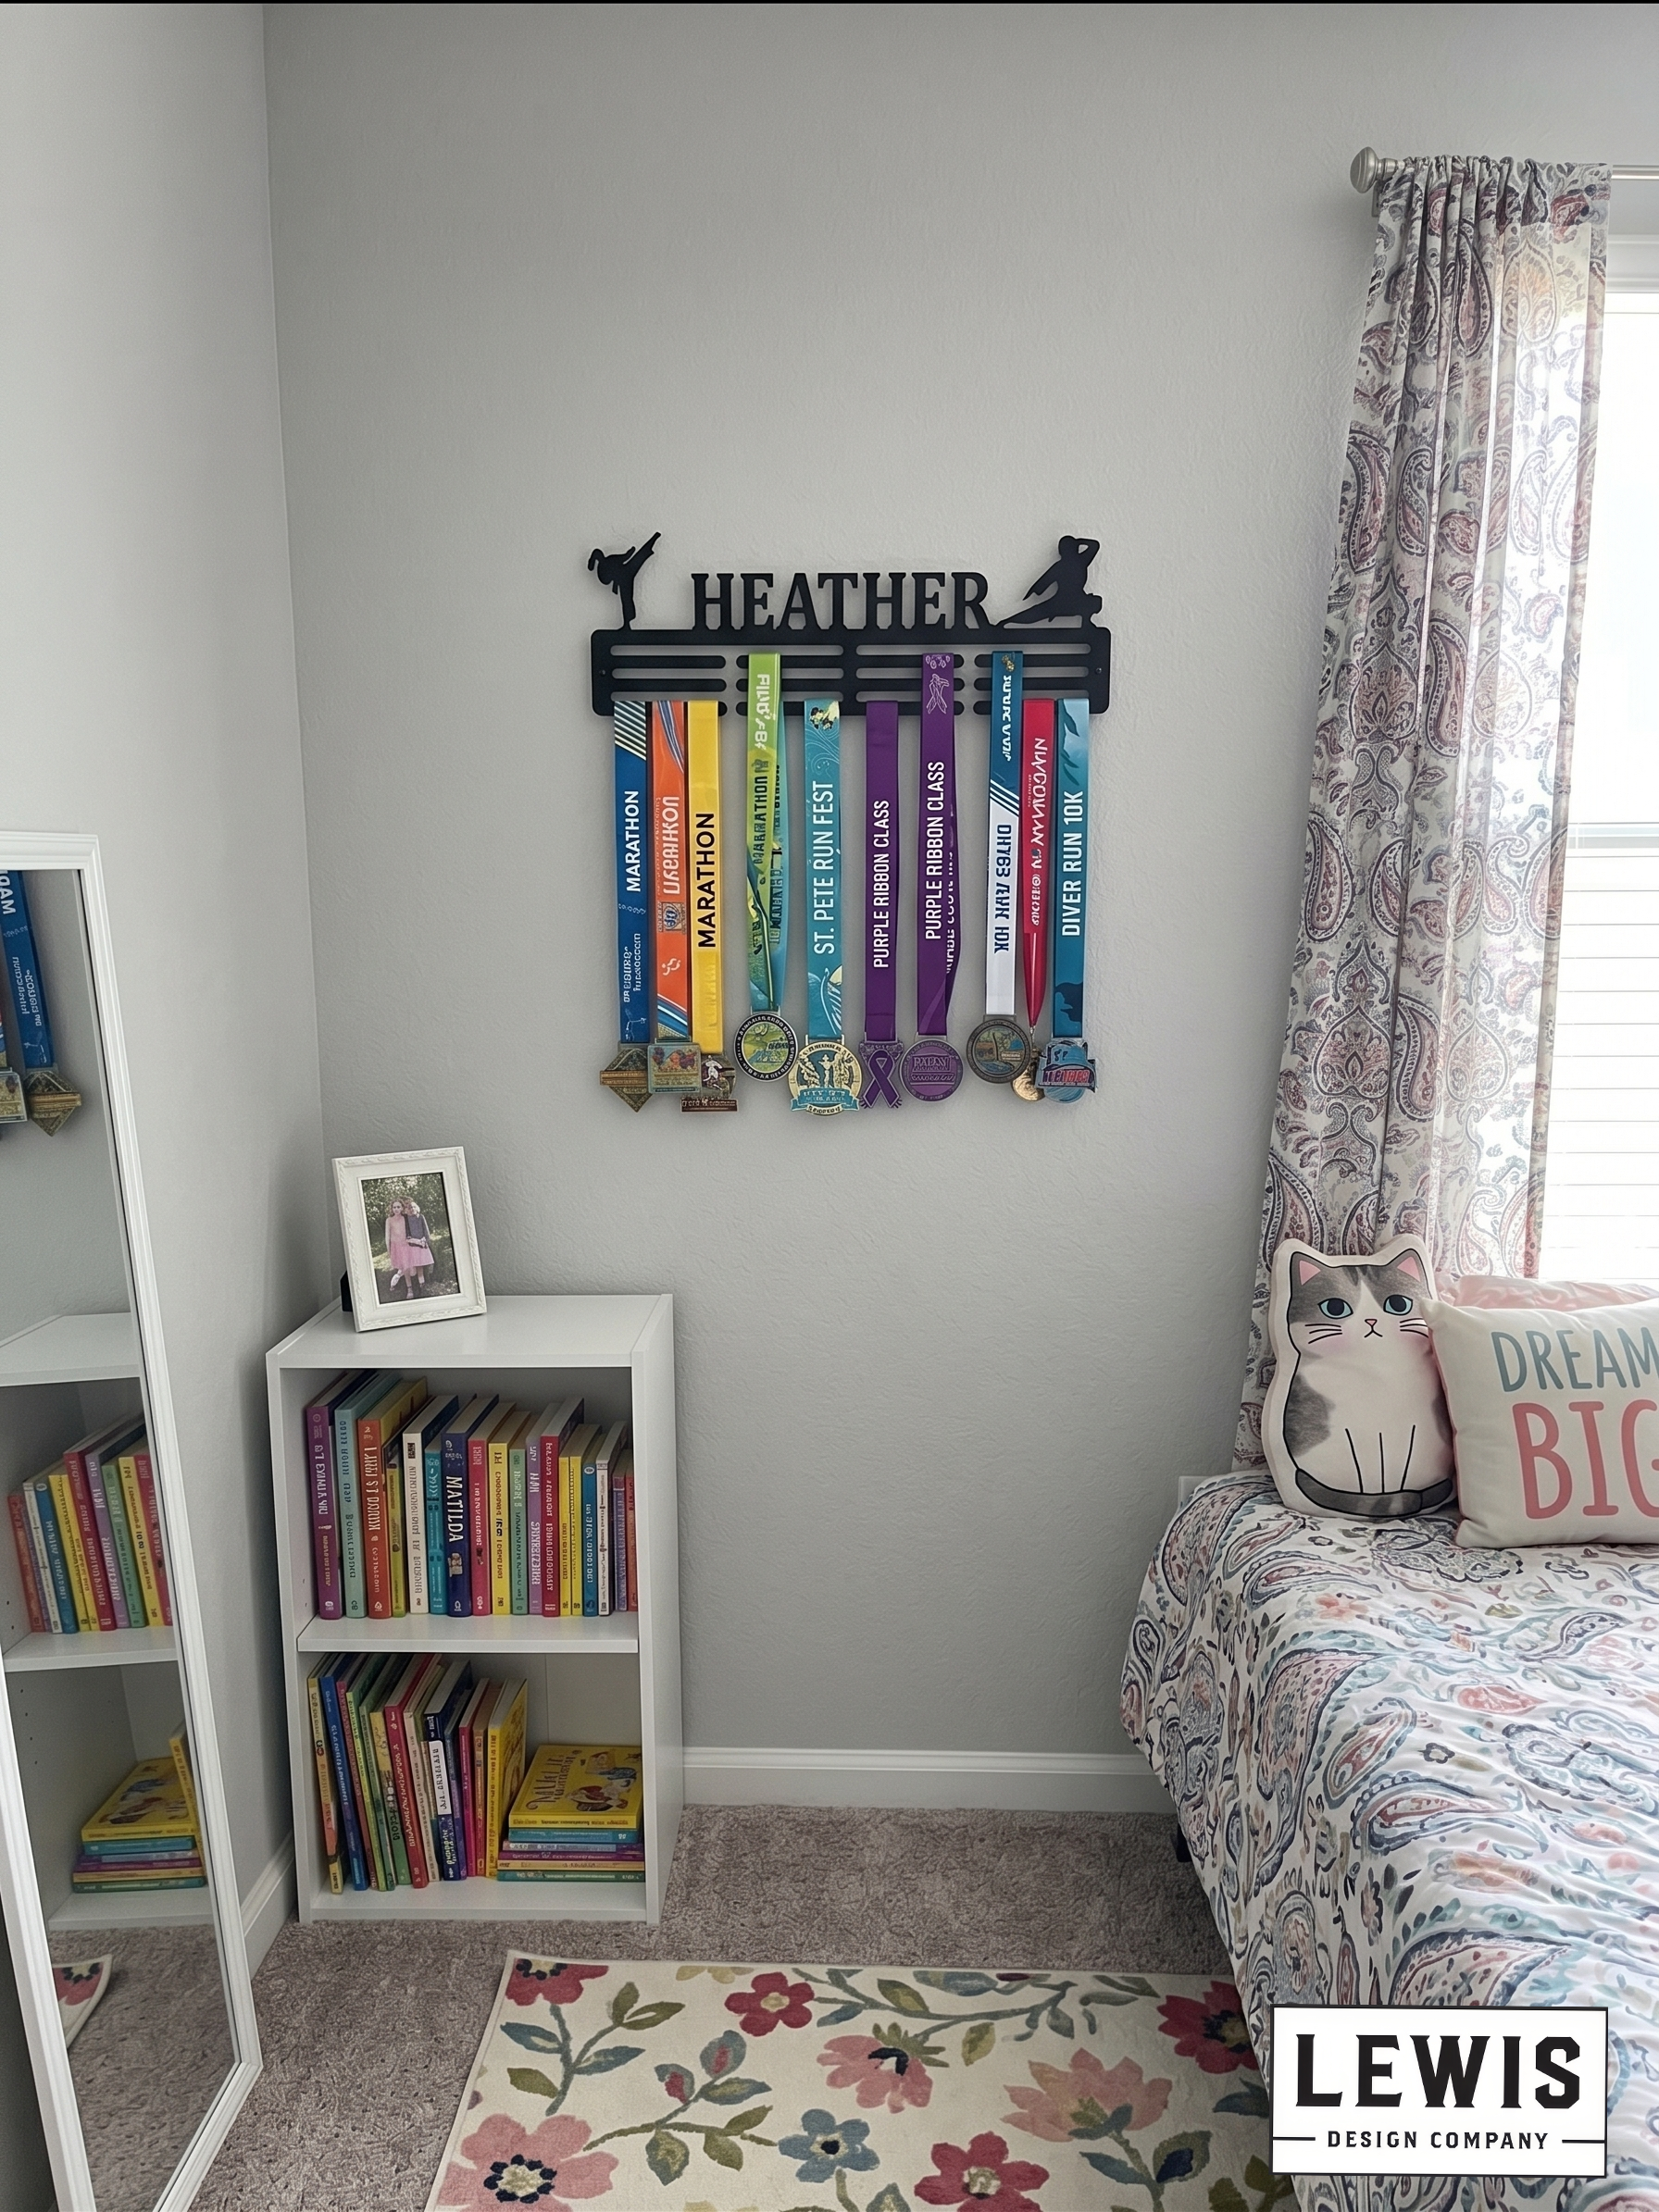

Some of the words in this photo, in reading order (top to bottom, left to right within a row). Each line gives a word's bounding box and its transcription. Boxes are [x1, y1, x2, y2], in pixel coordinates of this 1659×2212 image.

[691, 572, 994, 630] HEATHER
[812, 780, 834, 825] FEST
[927, 761, 944, 811] CLASS
[1063, 791, 1083, 826] 10K
[624, 790, 642, 892] MARATHON
[813, 831, 834, 870] RUN
[873, 800, 890, 848] CLASS
[926, 816, 944, 876] RIBBON
[873, 853, 890, 906] RIBBON
[1063, 833, 1082, 872] RUN
[695, 814, 717, 948] MARATHON
[813, 877, 834, 921] PETE
[1062, 880, 1081, 936] DIVER
[925, 880, 942, 939] PURPLE
[814, 927, 835, 954] ST.
[873, 911, 890, 968] PURPLE
[1491, 1326, 1659, 1392] DREAM
[1512, 1398, 1659, 1519] BIG
[445, 1475, 464, 1543] MATILDA
